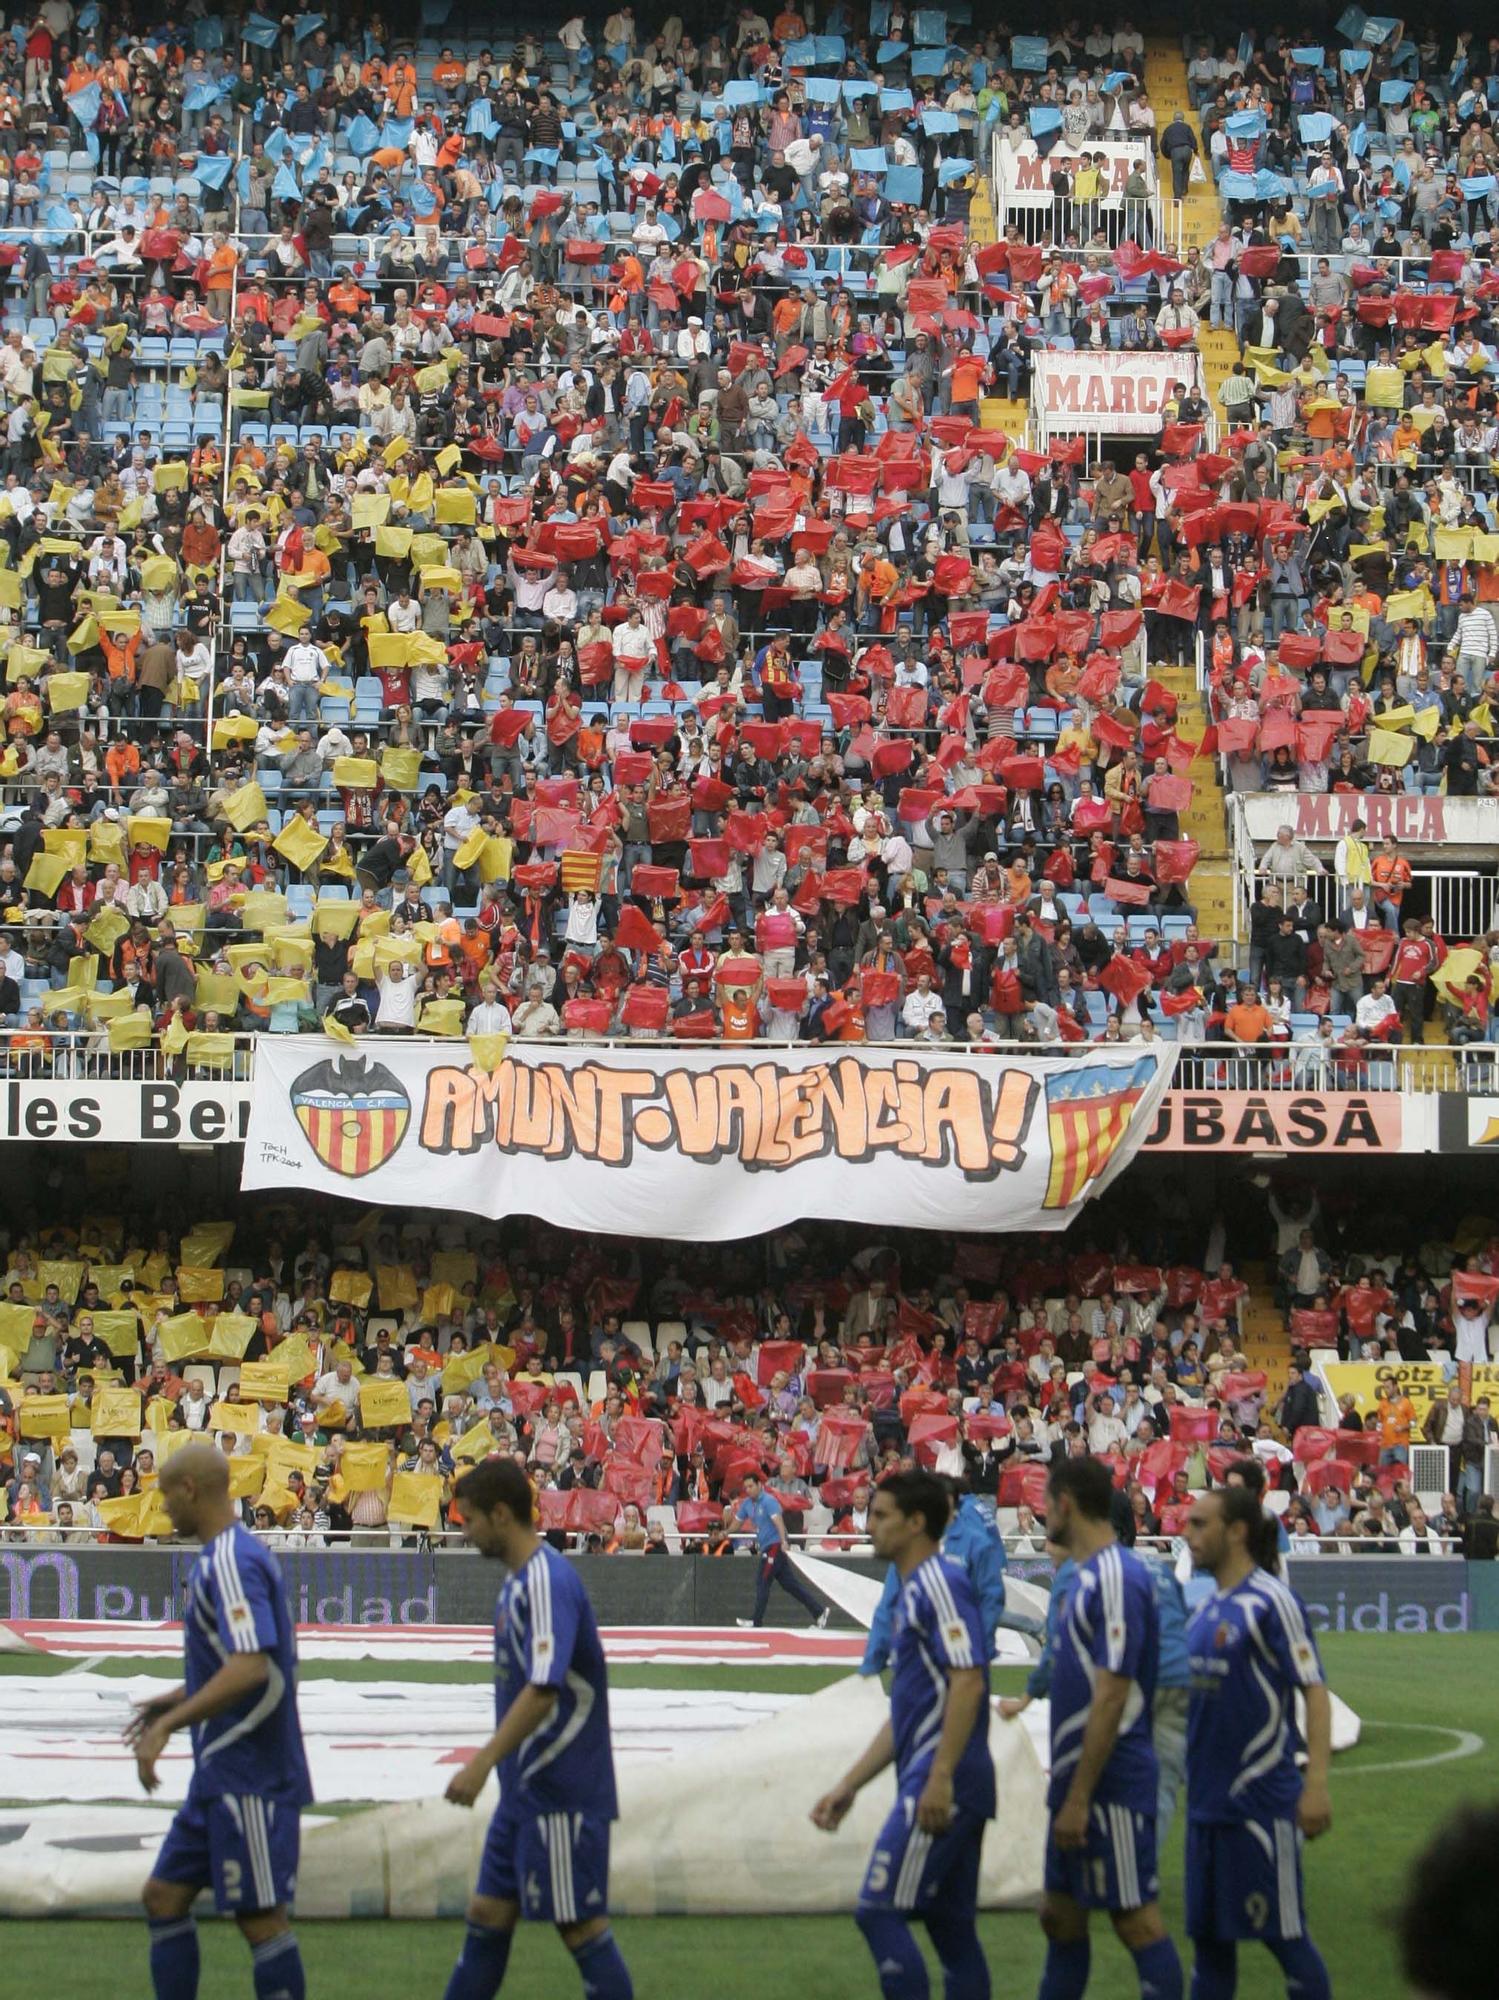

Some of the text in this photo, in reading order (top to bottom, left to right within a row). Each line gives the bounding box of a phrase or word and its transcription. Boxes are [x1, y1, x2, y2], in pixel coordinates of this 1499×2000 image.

[1295, 794, 1448, 841] MARCA
[300, 1095, 354, 1109] VALENCIA
[222, 1859, 243, 1900] 2
[1244, 1892, 1268, 1931] 9
